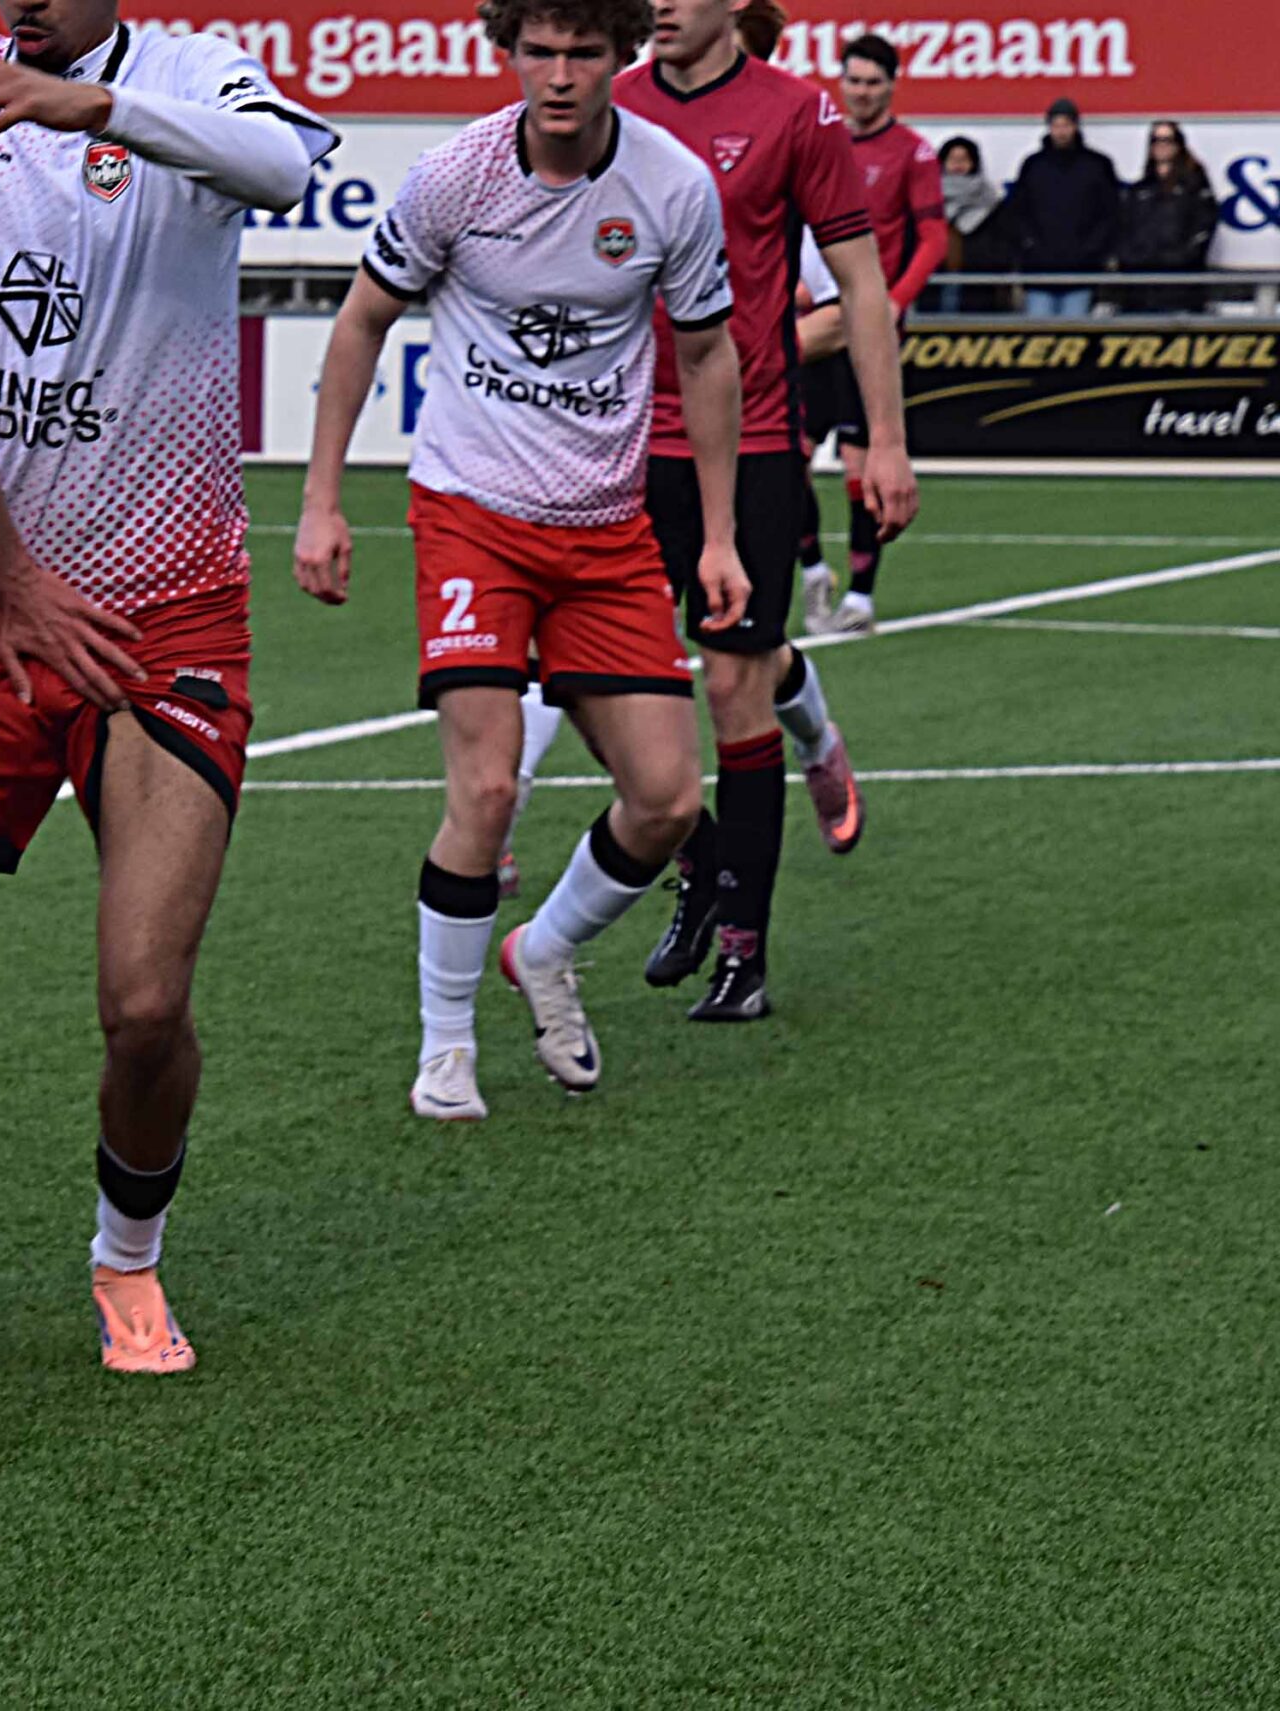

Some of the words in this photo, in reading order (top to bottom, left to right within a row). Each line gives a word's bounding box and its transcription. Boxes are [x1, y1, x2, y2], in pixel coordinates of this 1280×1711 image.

[304, 15, 502, 98] gaan
[1096, 335, 1278, 368] TRAVEL
[1143, 397, 1250, 436] travel
[440, 577, 477, 633] 2
